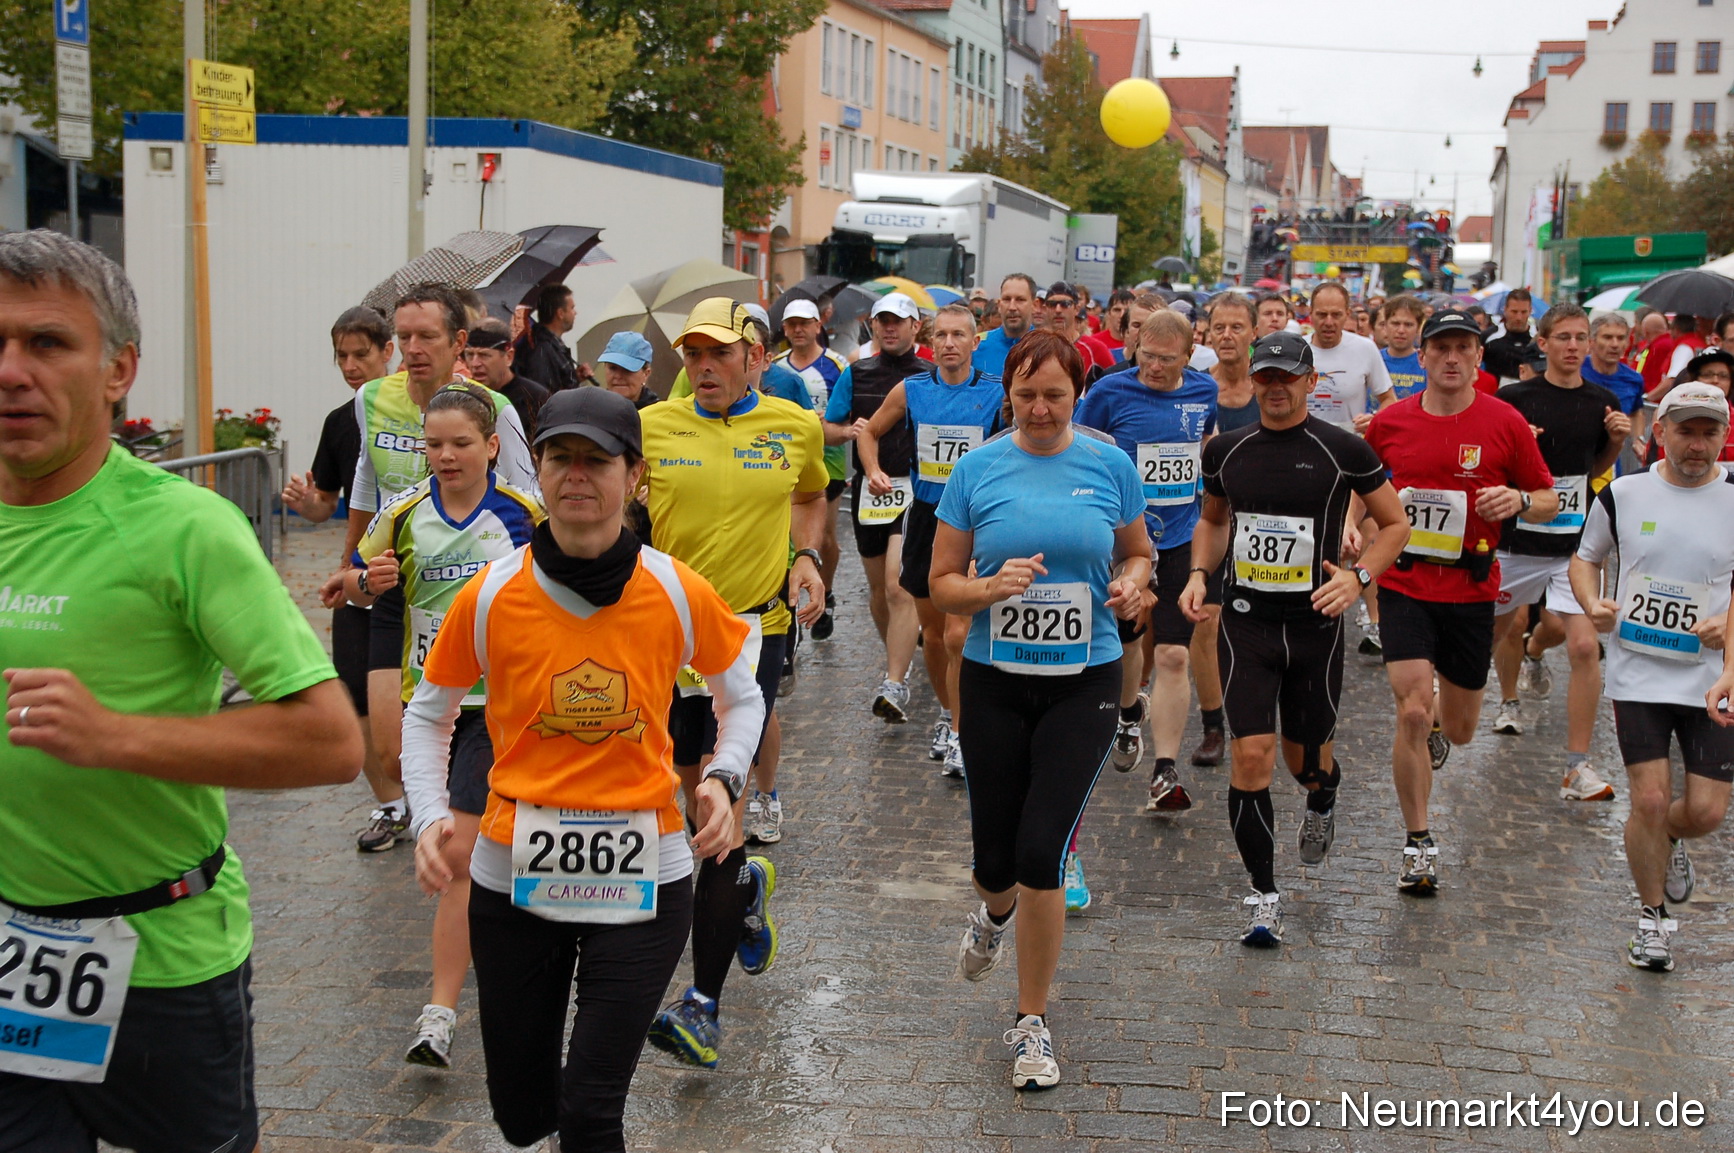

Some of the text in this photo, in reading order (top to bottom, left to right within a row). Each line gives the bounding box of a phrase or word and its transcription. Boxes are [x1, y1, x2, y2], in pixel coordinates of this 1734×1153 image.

[864, 214, 925, 228] BOCK
[1075, 244, 1116, 263] BO
[1328, 249, 1369, 260] START
[767, 431, 793, 441] Turbo
[733, 448, 763, 459] Turtles
[931, 441, 970, 462] 176
[660, 457, 702, 467] Markus
[1144, 459, 1194, 483] 2533
[1157, 486, 1182, 497] Marek
[1404, 504, 1451, 532] 817
[422, 549, 473, 567] TEAM
[1247, 534, 1297, 565] 387
[1250, 567, 1290, 582] Richard
[1648, 580, 1684, 595] BOCK
[1629, 593, 1699, 632] 2565
[21, 621, 64, 632] LEBEN.
[1000, 606, 1082, 641] 2826
[1634, 629, 1679, 649] Gerhard
[416, 633, 437, 668] 5
[1014, 646, 1066, 665] Dagmar
[576, 720, 602, 728] TEAM
[527, 830, 645, 875] 2862
[547, 884, 628, 901] CAROLINE
[0, 936, 110, 1019] 256
